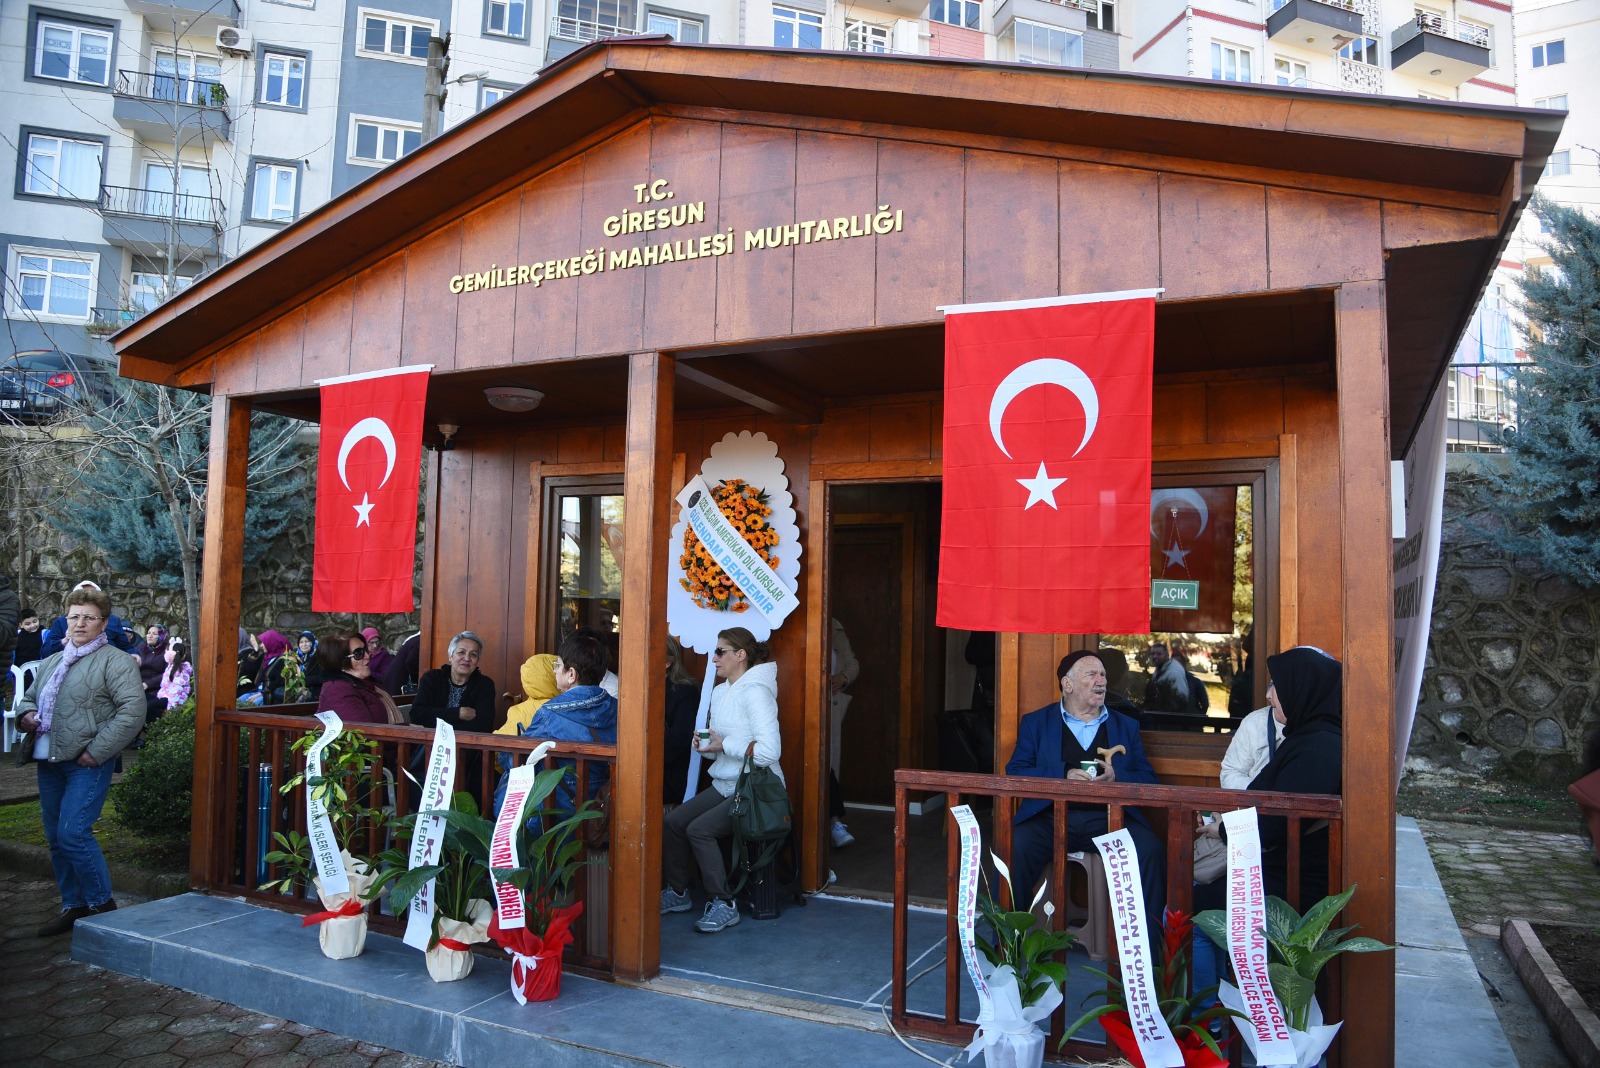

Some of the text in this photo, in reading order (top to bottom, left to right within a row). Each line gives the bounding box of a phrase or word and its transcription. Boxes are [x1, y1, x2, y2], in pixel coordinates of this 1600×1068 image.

[603, 200, 705, 237] GİRESUN
[633, 179, 674, 203] T.C.
[449, 205, 904, 294] GEMİLERÇEKEĞİ MAHALLESİ MUHTARLIĞI
[690, 509, 775, 615] GÜLENDAM BEKDEMİR
[715, 524, 747, 559] AMERİKAN
[742, 555, 756, 571] DİL
[752, 566, 785, 602] KURSLARI
[1161, 587, 1189, 601] AÇIK
[428, 745, 444, 799] GİRESUN
[499, 792, 525, 822] MERKEZ
[312, 830, 331, 851] İŞLERİ
[318, 851, 340, 878] ŞEFLİĞİ
[415, 804, 432, 863] BELEDİYE
[959, 836, 983, 990] SIVACI KÖYÜ MUHTARI
[967, 827, 978, 928] EMRAH
[1101, 842, 1151, 1043] KÜMBETLİ FINDIK
[1112, 838, 1164, 1040] SÜLEYMAN KÜMBETLİ
[1232, 868, 1273, 1042] AK PARTİ GİRESUN MERKEZ İLÇE BAŞKANI
[1250, 865, 1289, 1040] EKREM FARUK CİVELEKOĞLU
